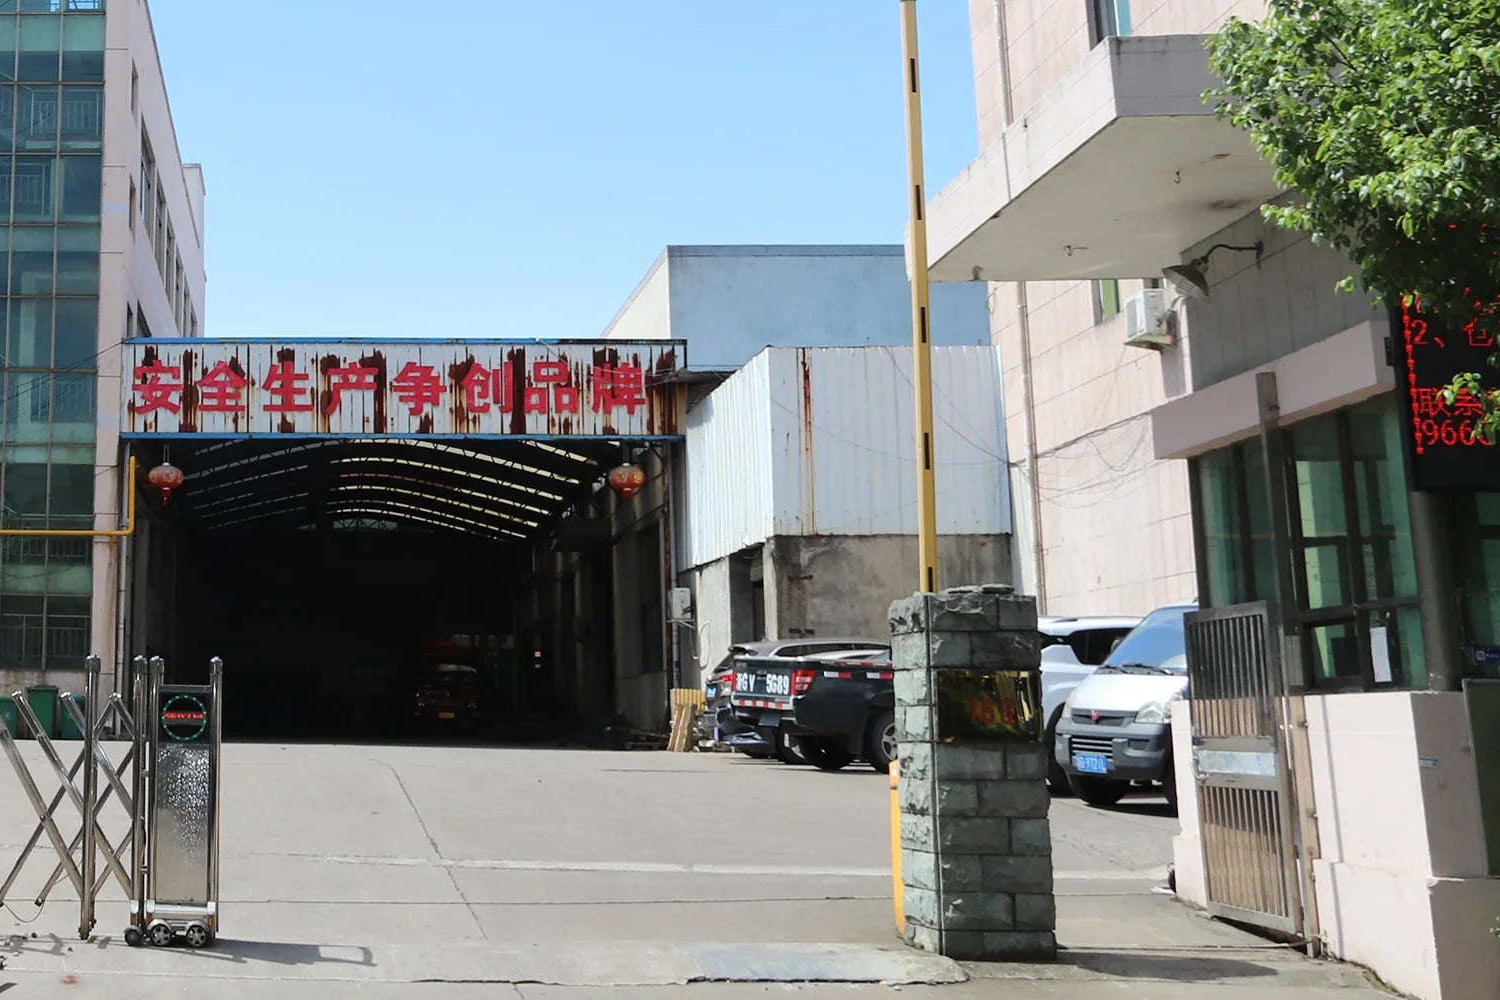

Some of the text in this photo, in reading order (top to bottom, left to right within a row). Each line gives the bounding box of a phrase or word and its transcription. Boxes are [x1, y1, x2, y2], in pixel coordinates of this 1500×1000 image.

[131, 359, 646, 415] 安全生产争创品牌
[1418, 387, 1500, 417] 联系
